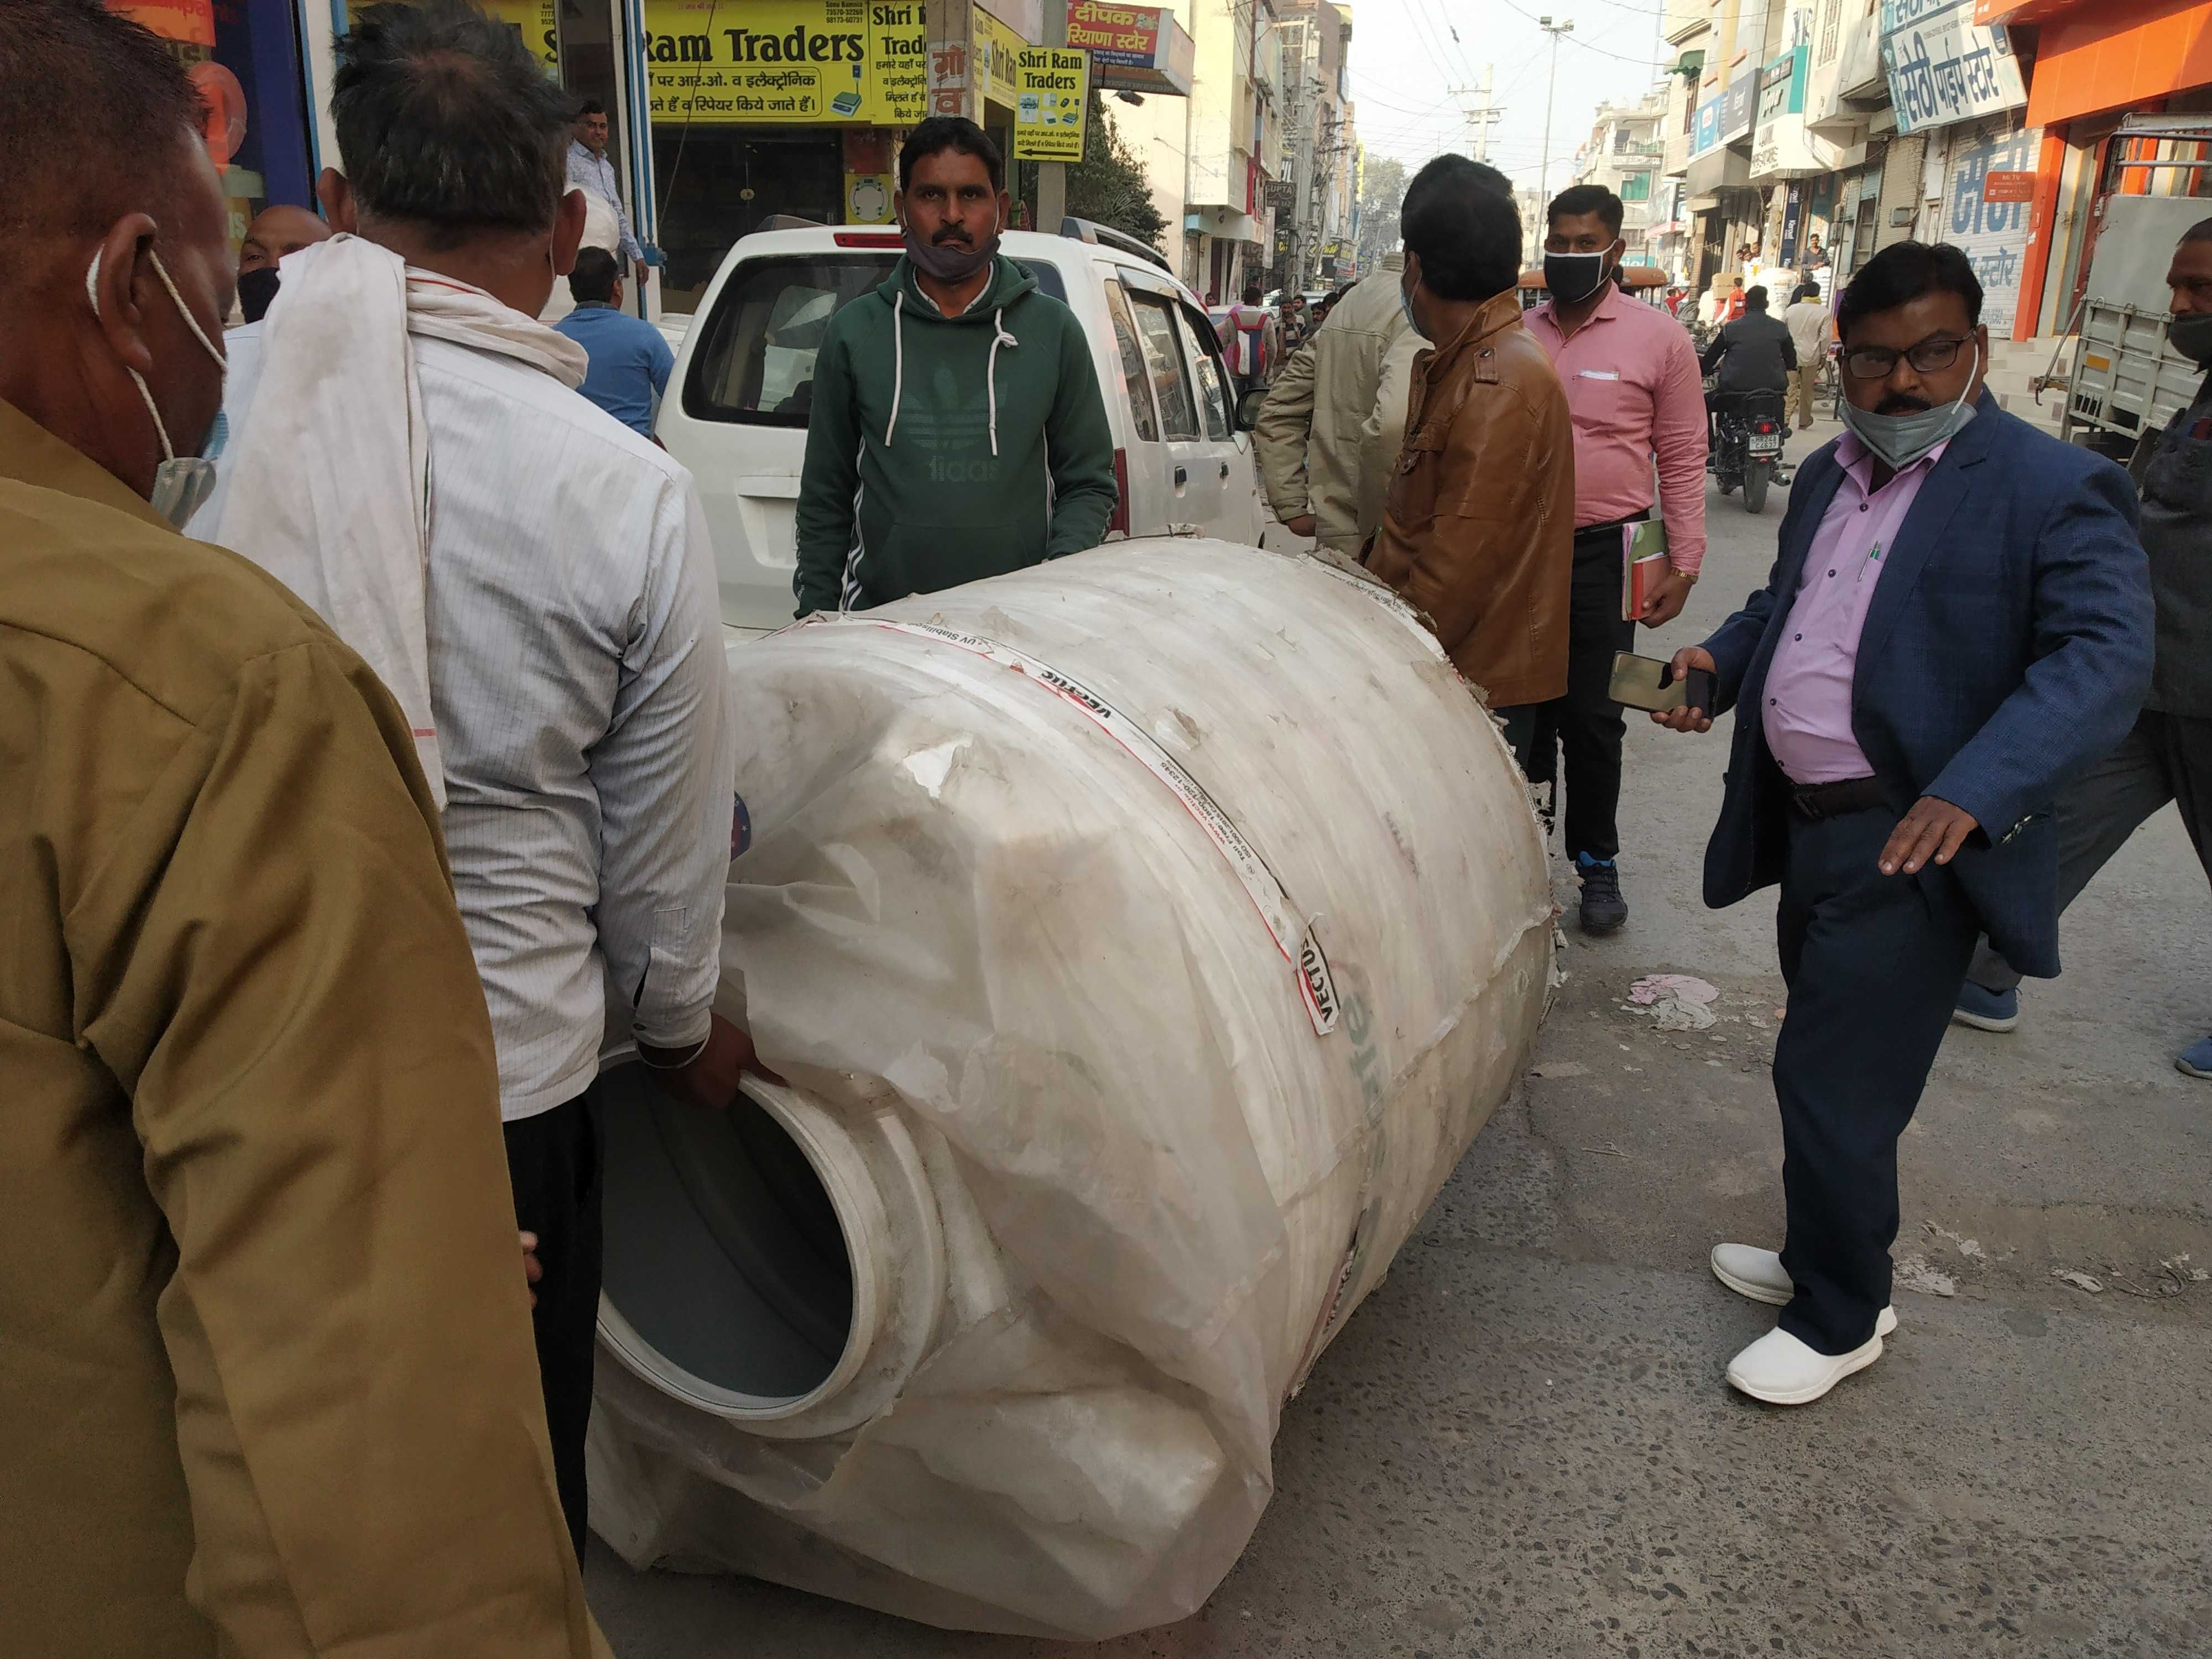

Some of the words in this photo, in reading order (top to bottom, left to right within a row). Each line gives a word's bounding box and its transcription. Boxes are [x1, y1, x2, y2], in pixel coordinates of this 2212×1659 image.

[873, 5, 911, 25] Shri
[1074, 2, 1137, 25] दीपक
[723, 25, 864, 62] Traders
[881, 35, 927, 55] Trad
[1067, 22, 1113, 47] रियाणा
[1117, 30, 1149, 50] स्टोर
[1019, 51, 1047, 68] Shri
[1051, 53, 1083, 70] Ram
[657, 75, 674, 87] पर
[890, 75, 927, 88] इलैक्ट्रोनि
[1024, 72, 1076, 90] Traders
[737, 95, 764, 111] किये
[768, 96, 795, 111] जाते
[959, 637, 977, 645] UV
[1233, 845, 1245, 863] Toll
[1241, 845, 1252, 859] ISO
